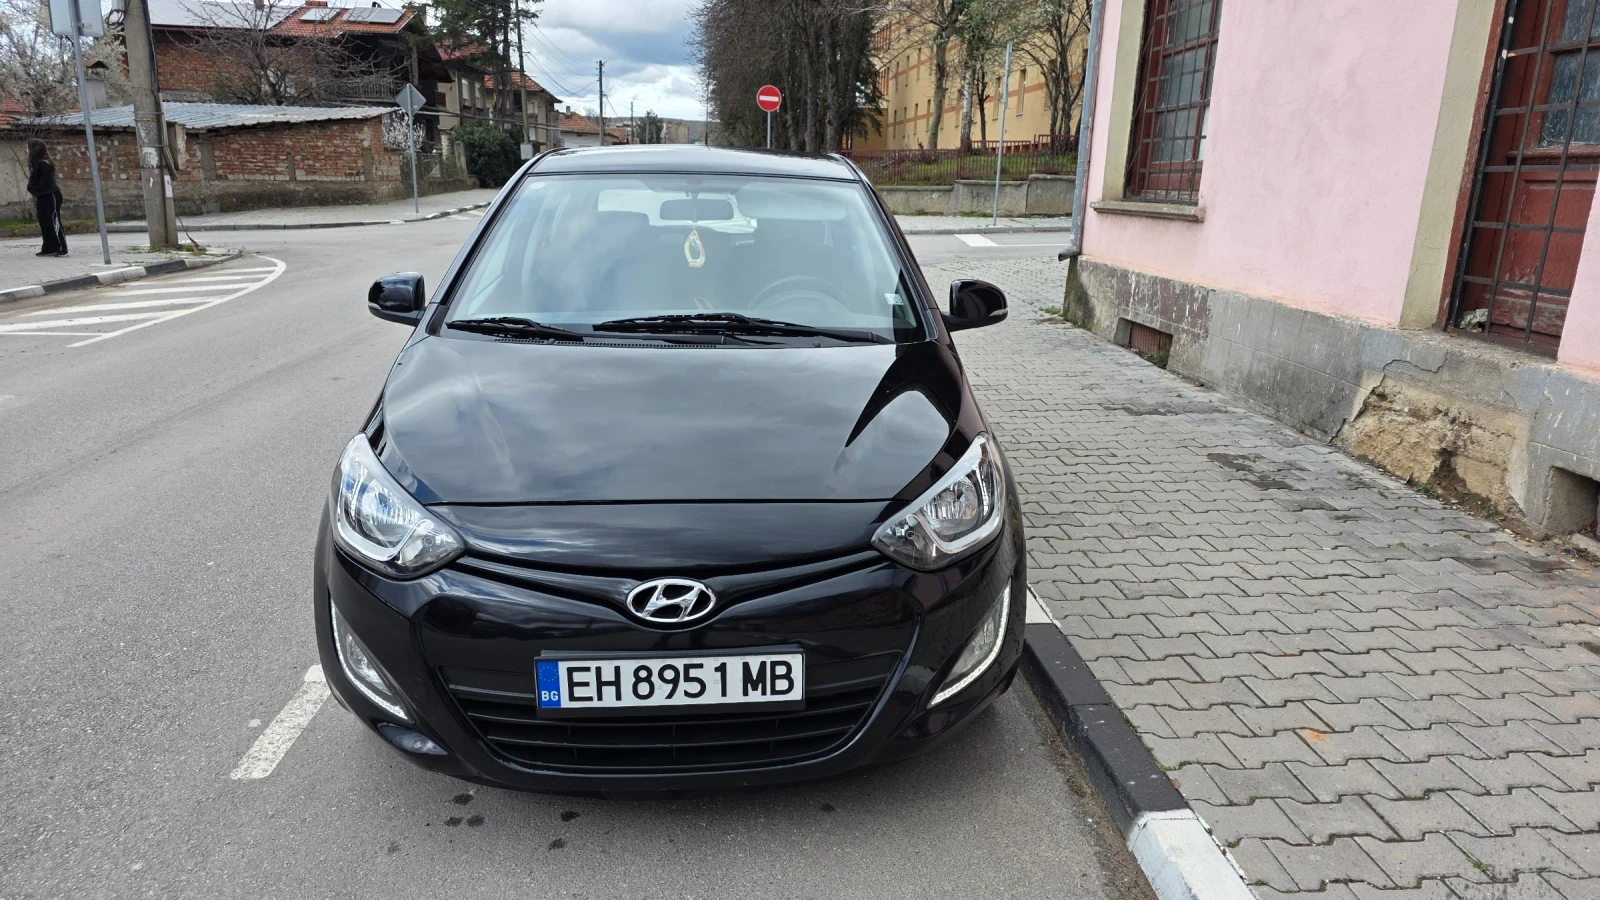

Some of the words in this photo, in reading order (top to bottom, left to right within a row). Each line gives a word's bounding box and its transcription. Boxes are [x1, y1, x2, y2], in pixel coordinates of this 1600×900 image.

[566, 665, 623, 702] EH
[631, 661, 728, 700] 8951
[741, 660, 795, 697] MB
[541, 690, 559, 702] BG
